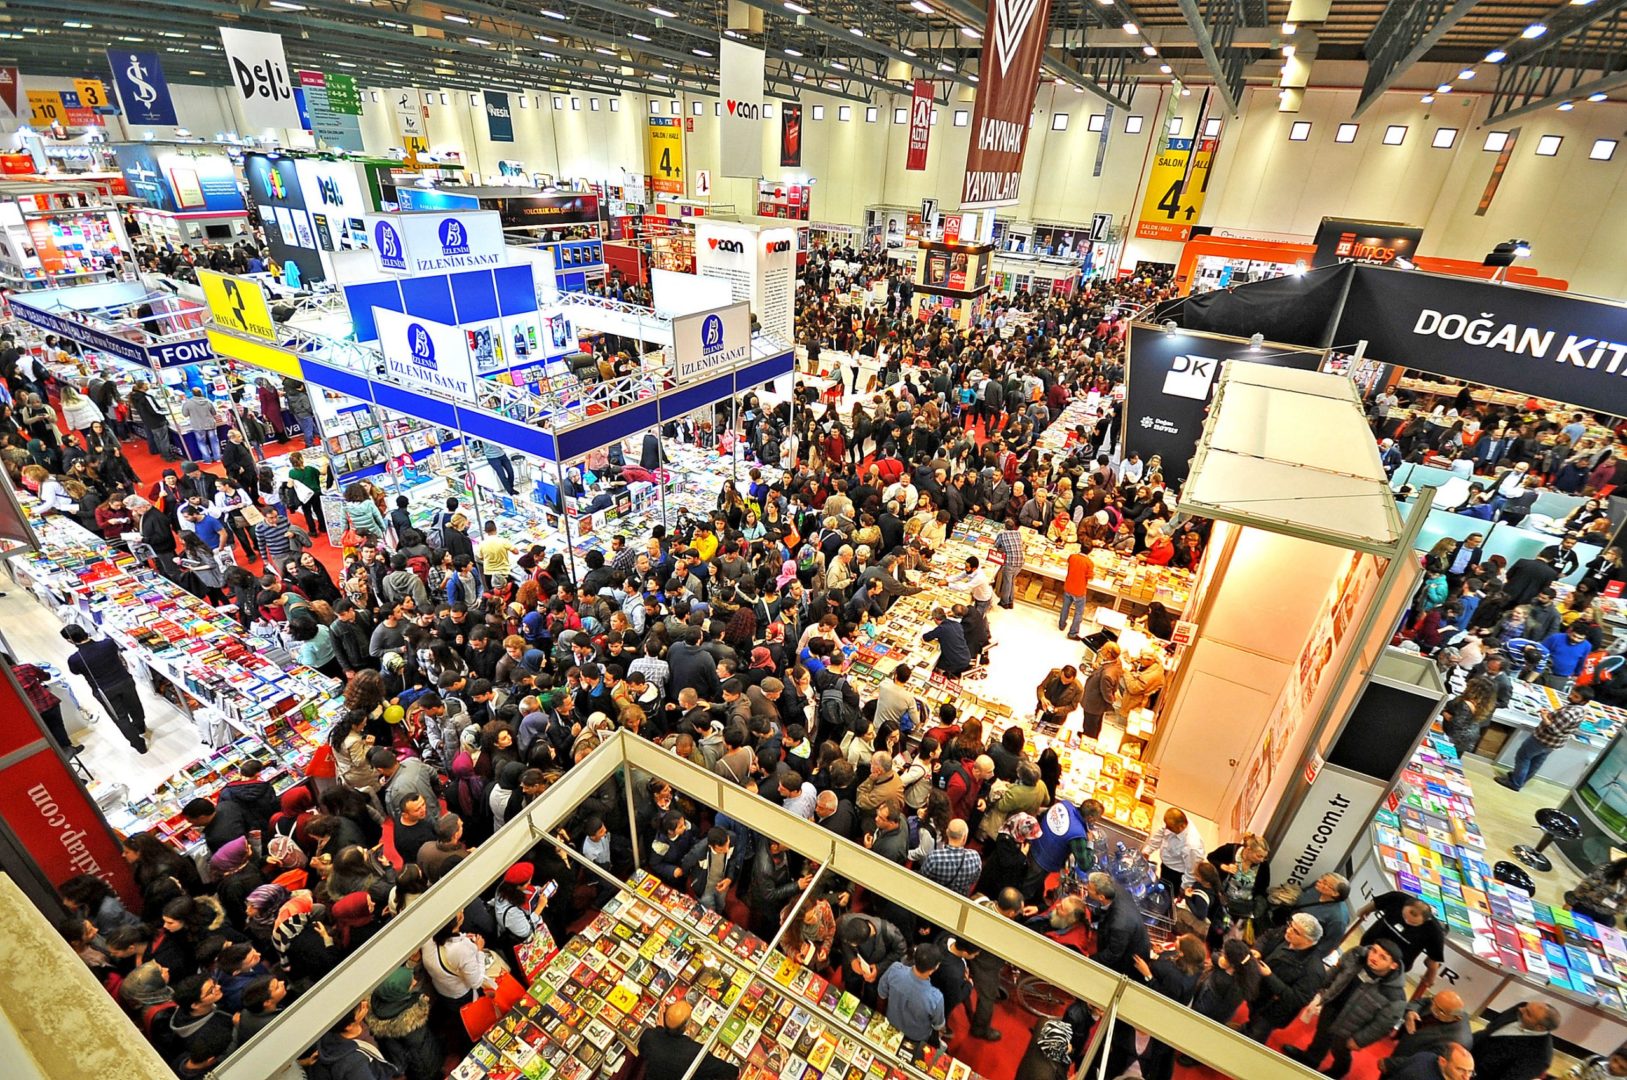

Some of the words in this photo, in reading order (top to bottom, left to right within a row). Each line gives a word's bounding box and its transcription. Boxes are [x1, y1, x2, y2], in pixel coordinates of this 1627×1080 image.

[84, 87, 99, 105] 3
[38, 104, 57, 119] 10
[736, 103, 759, 120] can
[652, 131, 666, 139] SALON
[978, 117, 1024, 153] KAYNAK
[659, 147, 672, 177] 4
[1158, 157, 1184, 168] SALON
[965, 171, 1020, 202] YAYINLARI
[1157, 179, 1183, 219] 4
[717, 240, 744, 254] can
[773, 240, 791, 253] can
[417, 255, 466, 272] İZLENİM
[467, 253, 499, 266] SANAT
[215, 314, 239, 328] HAYAL
[249, 323, 274, 338] PEREST
[1413, 309, 1555, 358] DOĞAN
[1555, 335, 1627, 378] KİT
[682, 354, 719, 376] İZLENİM
[720, 345, 746, 364] SANAT
[1171, 355, 1211, 378] DK
[389, 356, 432, 383] İZLENİM
[434, 373, 468, 394] SANAT
[1280, 793, 1351, 889] eratur.com.tr
